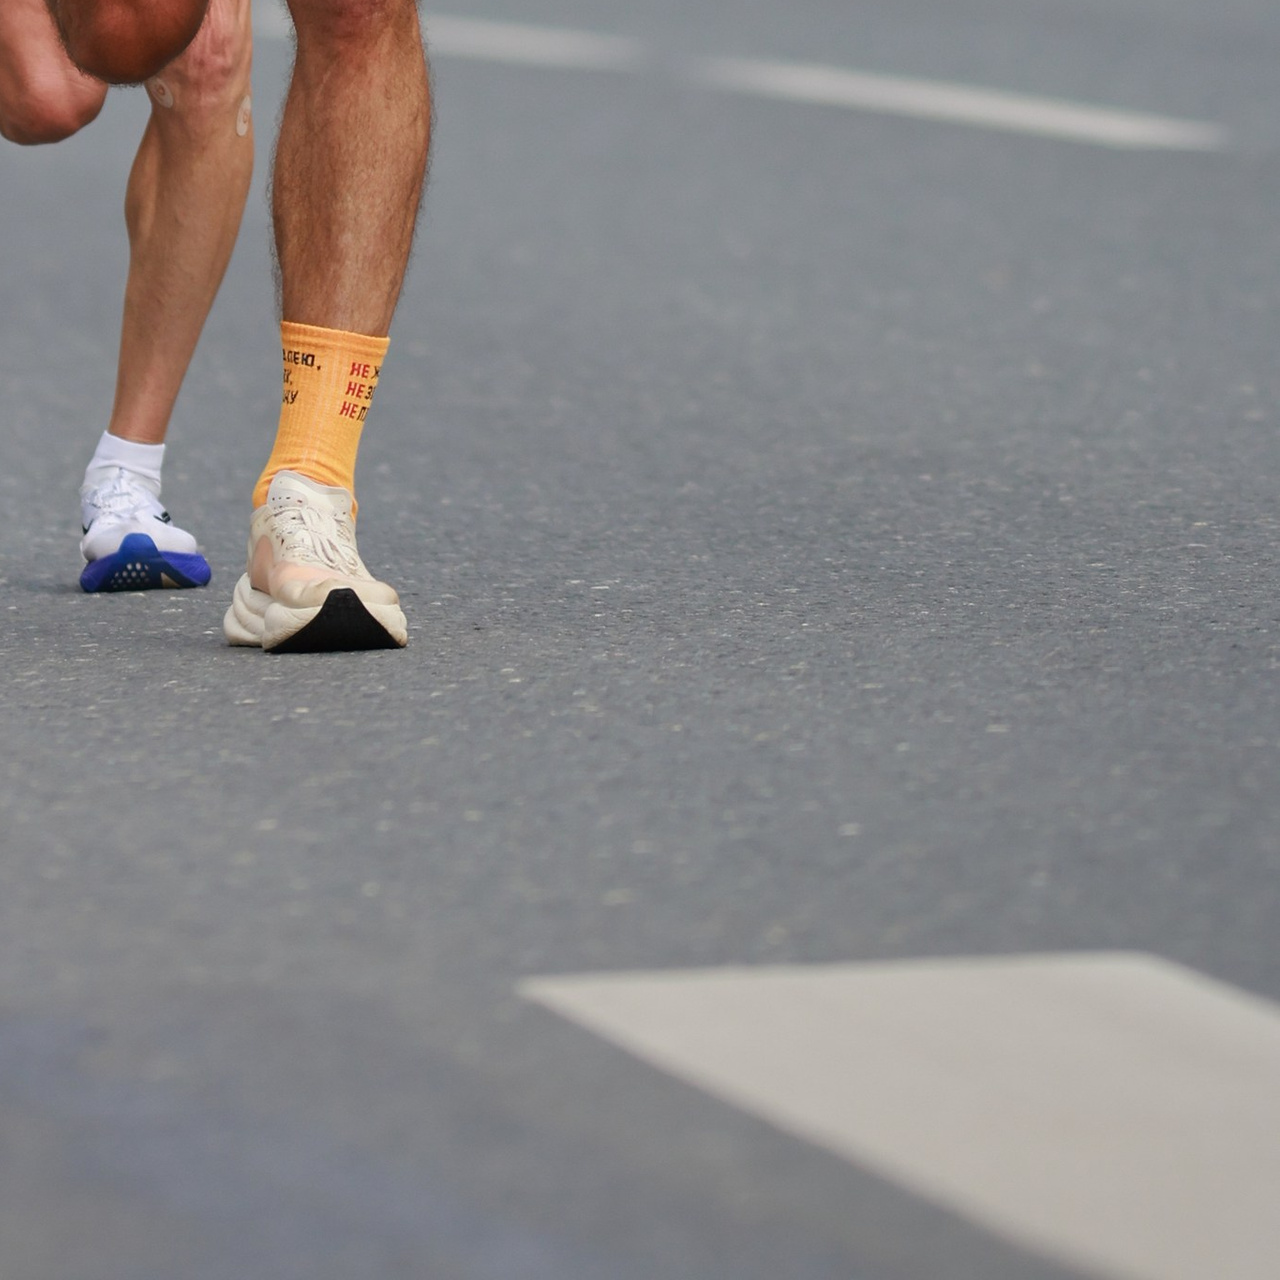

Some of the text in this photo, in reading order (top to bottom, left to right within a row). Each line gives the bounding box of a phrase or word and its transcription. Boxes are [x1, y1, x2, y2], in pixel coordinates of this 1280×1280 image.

[350, 362, 371, 379] НЕ
[345, 381, 366, 399] НЕ
[339, 401, 359, 419] НЕ
